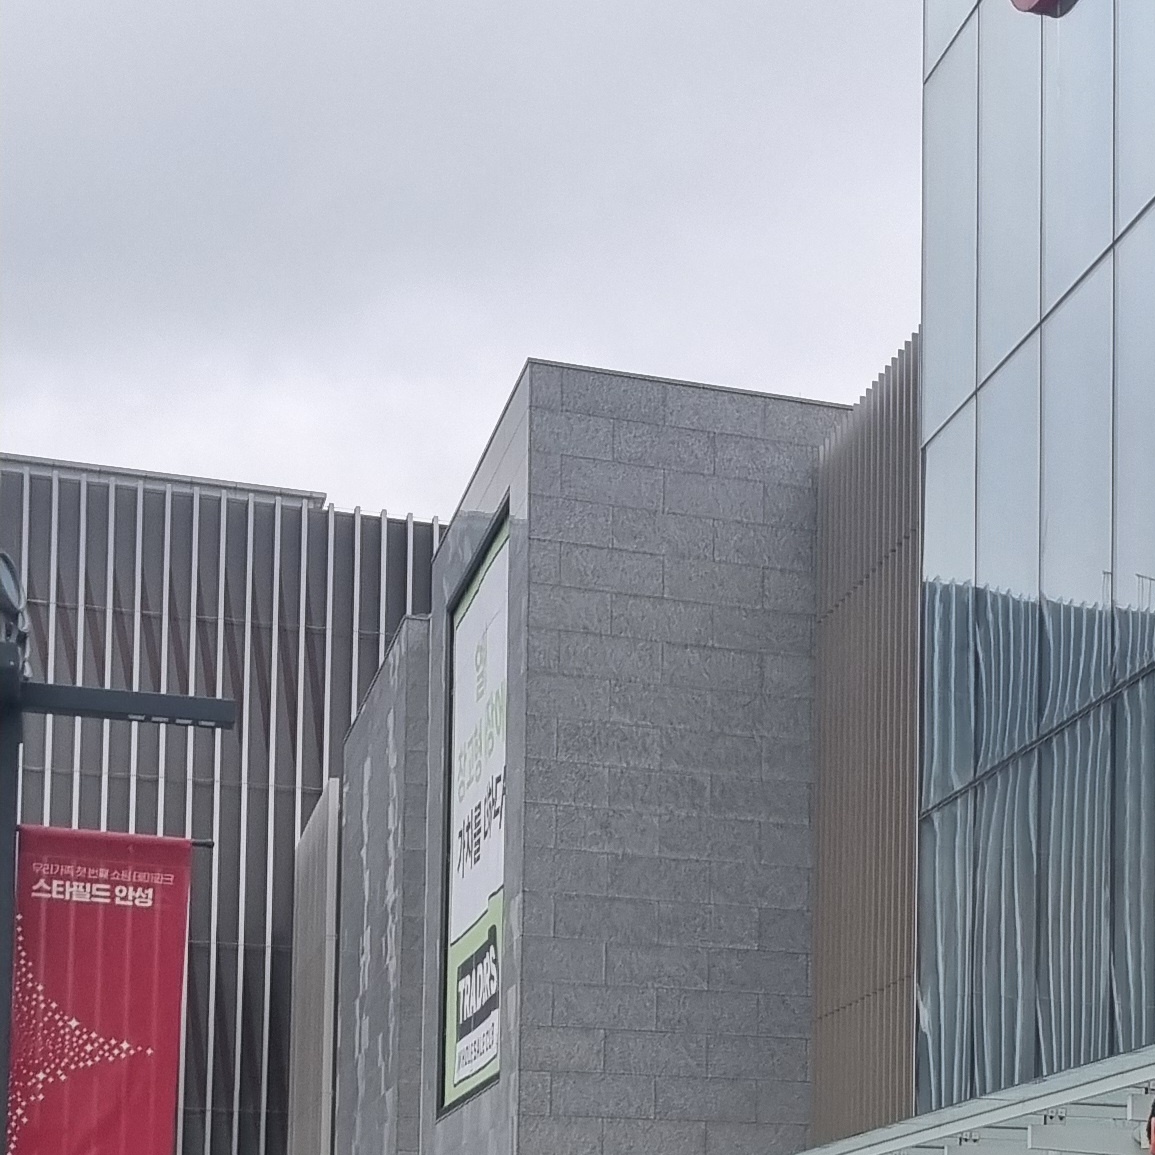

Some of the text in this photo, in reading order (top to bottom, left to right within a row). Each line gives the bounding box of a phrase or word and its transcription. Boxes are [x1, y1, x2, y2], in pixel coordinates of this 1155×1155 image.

[457, 800, 482, 878] 가치를
[32, 862, 74, 877] 우리가족
[76, 866, 87, 878] 첫
[88, 867, 109, 880] 번째
[132, 871, 175, 885] 테마파크
[31, 878, 154, 907] 스타필드 안성
